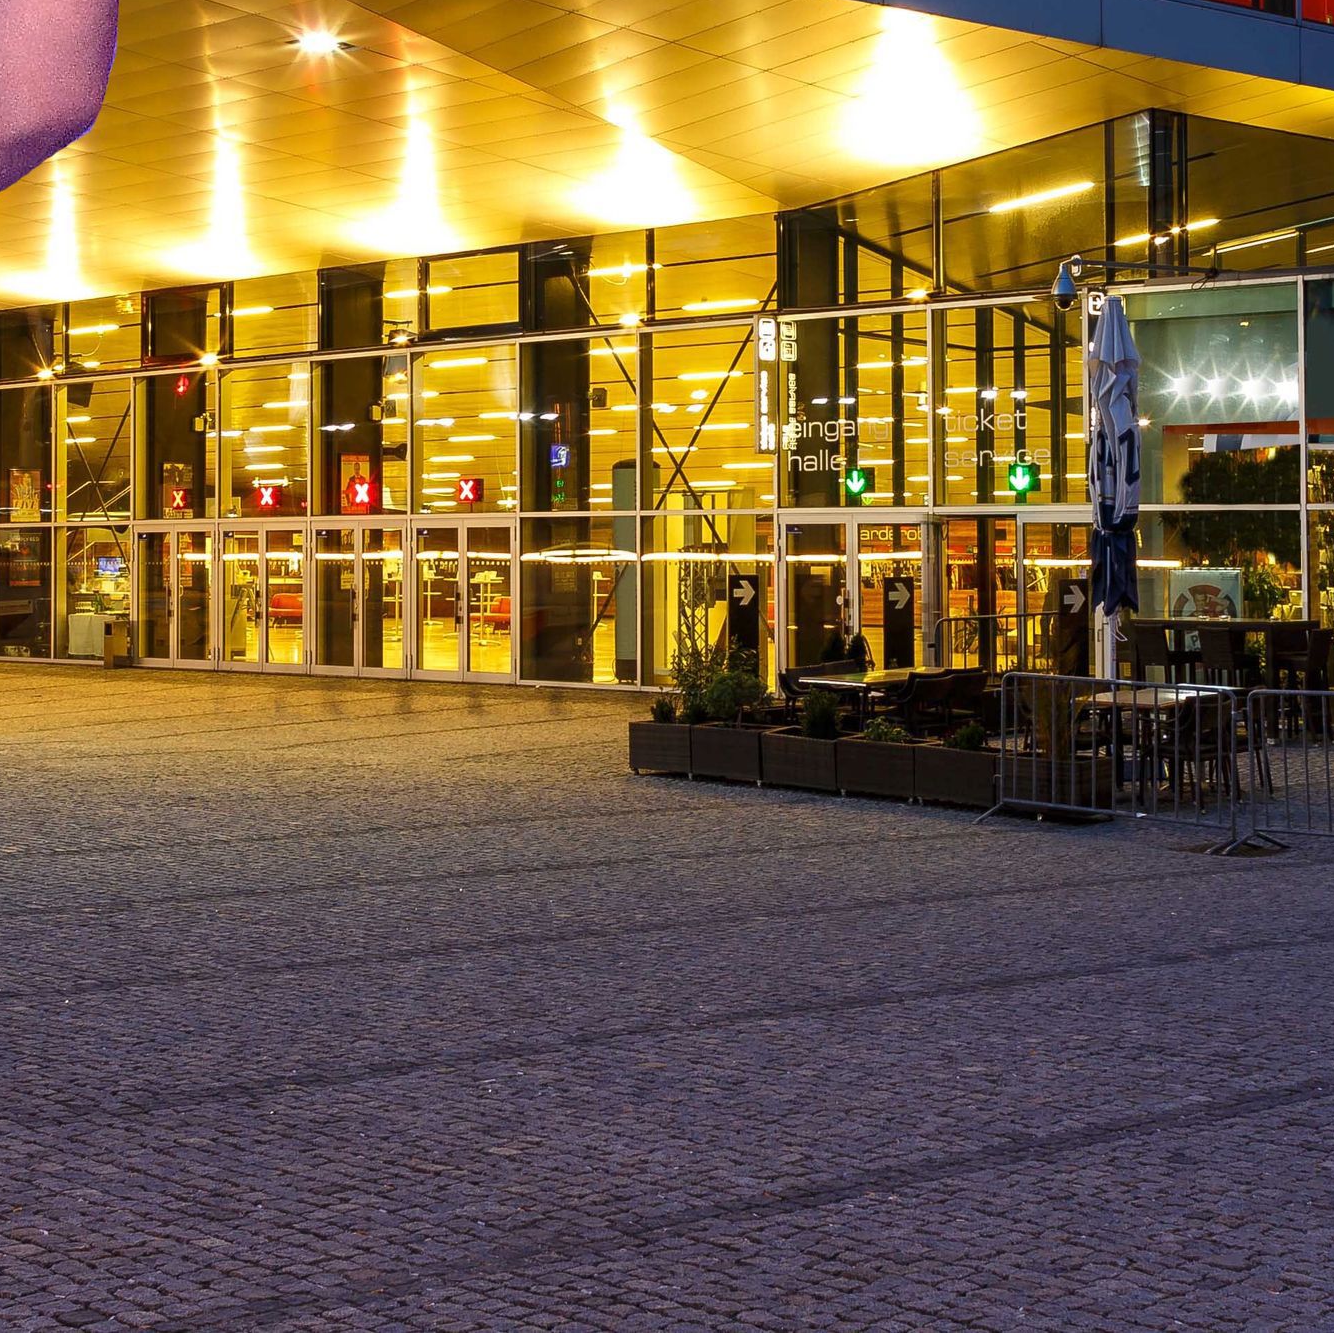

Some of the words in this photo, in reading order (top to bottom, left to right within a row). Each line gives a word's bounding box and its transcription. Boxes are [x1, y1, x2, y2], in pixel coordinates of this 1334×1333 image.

[794, 417, 889, 442] eingang
[943, 408, 1027, 433] ticket
[788, 449, 846, 472] halle
[944, 444, 1051, 468] service
